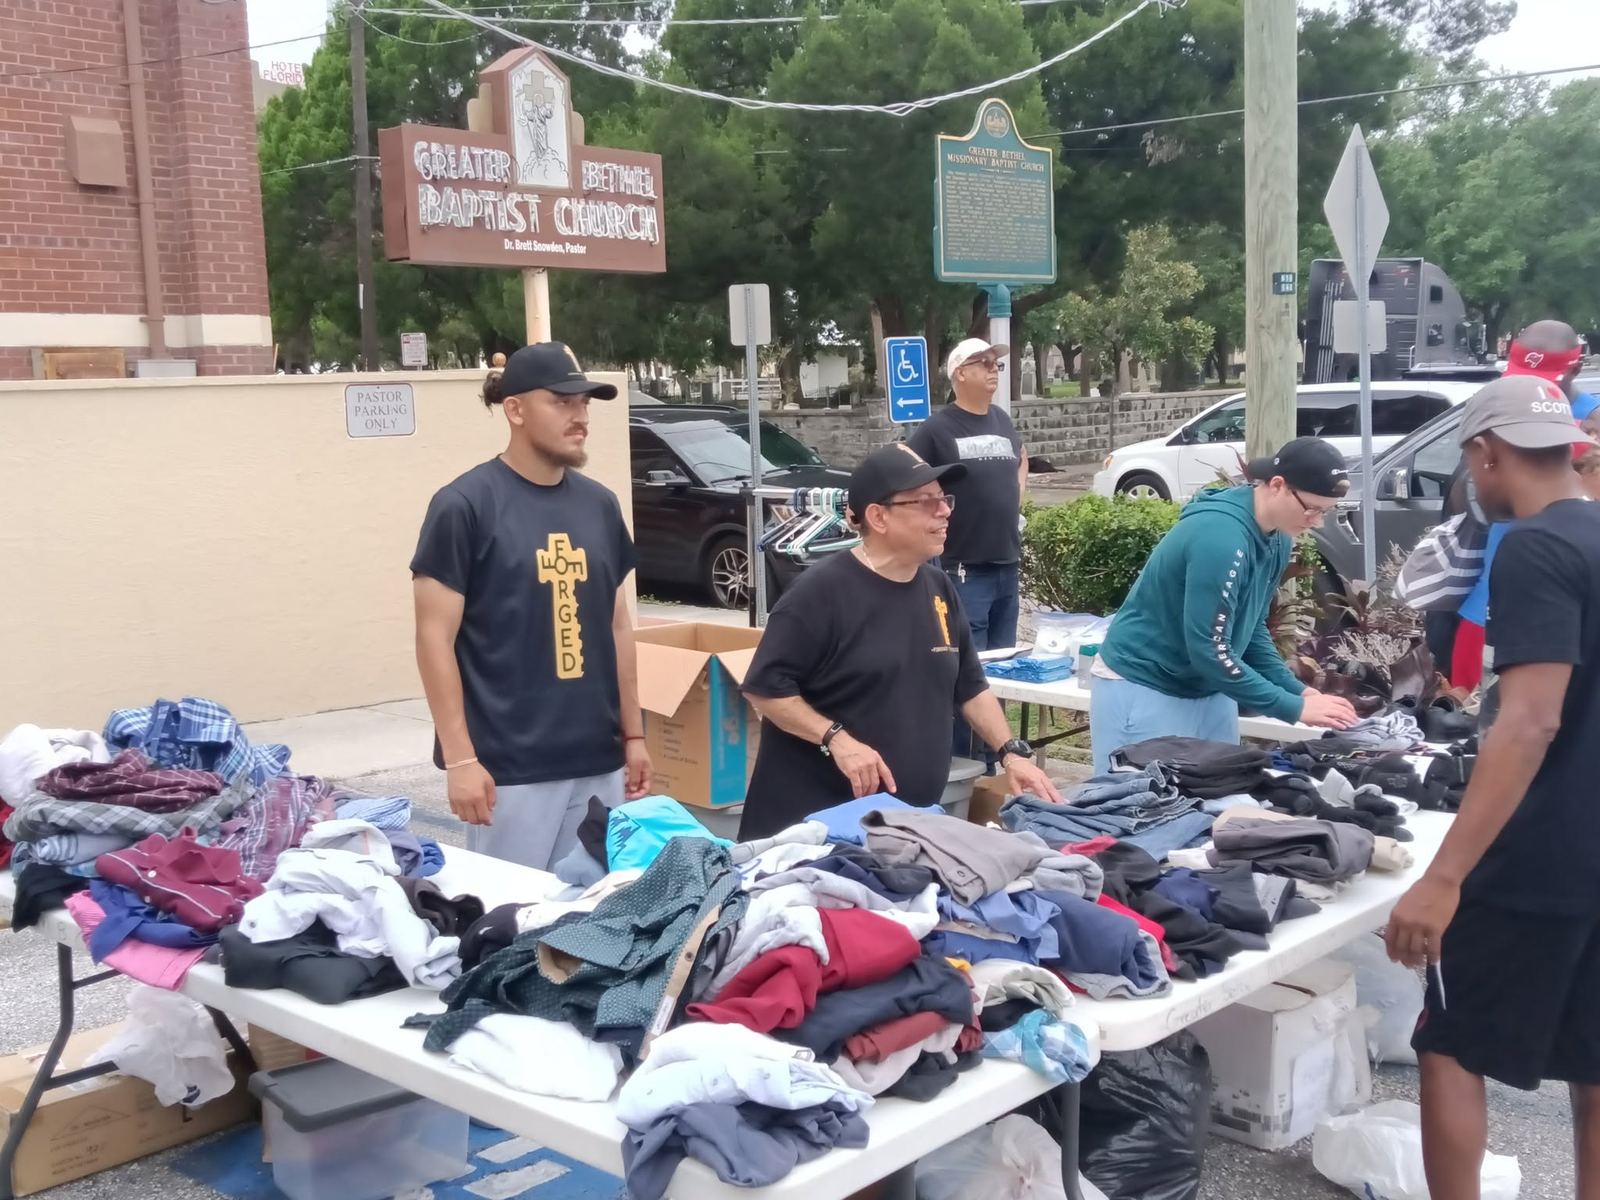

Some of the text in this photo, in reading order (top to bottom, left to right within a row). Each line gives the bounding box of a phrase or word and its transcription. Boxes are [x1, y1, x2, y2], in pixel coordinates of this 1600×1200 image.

[271, 60, 302, 74] HOTE
[263, 69, 304, 83] FLORID
[968, 146, 1026, 160] GREATER BETHEL
[414, 140, 658, 199] GREATER BETHEL
[947, 153, 1045, 173] MISSIONARY BAPTIST CHURCH
[418, 183, 659, 245] BAPTIST CHURCH
[504, 239, 587, 254] Dr. Brett Snowden, Pastor
[357, 391, 403, 403] PASTOR
[1537, 385, 1546, 400] I
[354, 404, 408, 417] PARKING
[1531, 401, 1570, 415] SCOT
[364, 418, 398, 430] ONLY
[1213, 549, 1244, 676] AMERCAN EAGLE
